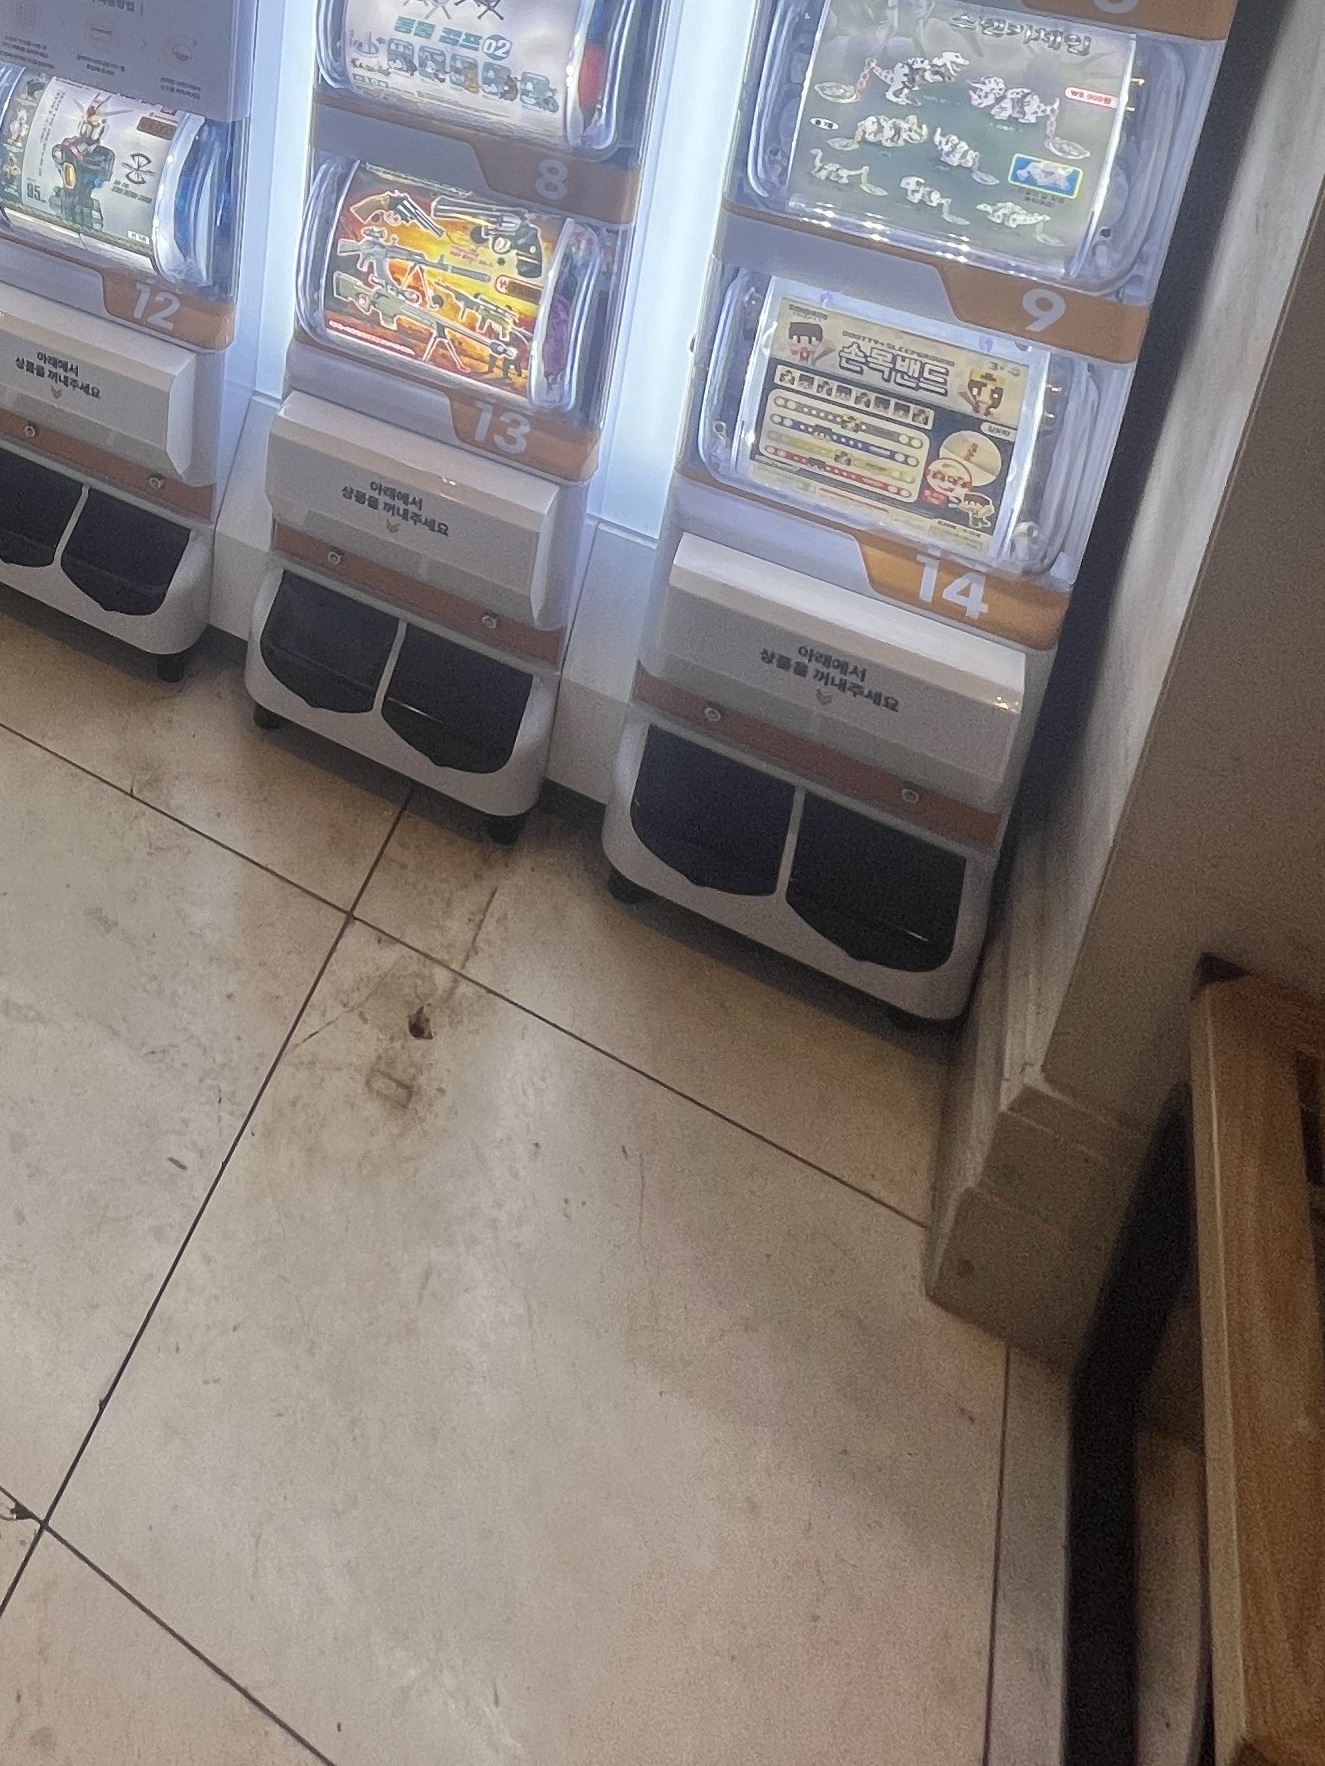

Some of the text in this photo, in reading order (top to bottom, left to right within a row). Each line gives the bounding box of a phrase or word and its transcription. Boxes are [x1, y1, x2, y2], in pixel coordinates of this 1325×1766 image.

[483, 38, 511, 57] 02
[535, 159, 569, 200] 8
[132, 285, 181, 331] 12
[1021, 288, 1067, 333] 9
[15, 357, 101, 399] 상품을 꺼내주세요
[37, 351, 80, 376] 아래에서
[838, 342, 950, 398] 손목밴드
[474, 400, 531, 455] 13
[341, 486, 450, 536] 상품을 꺼내주세요
[369, 480, 423, 511] 아래에서
[917, 547, 989, 620] 14
[760, 648, 899, 713] 상품을 꺼내주세요
[797, 645, 867, 683] 아래에서
